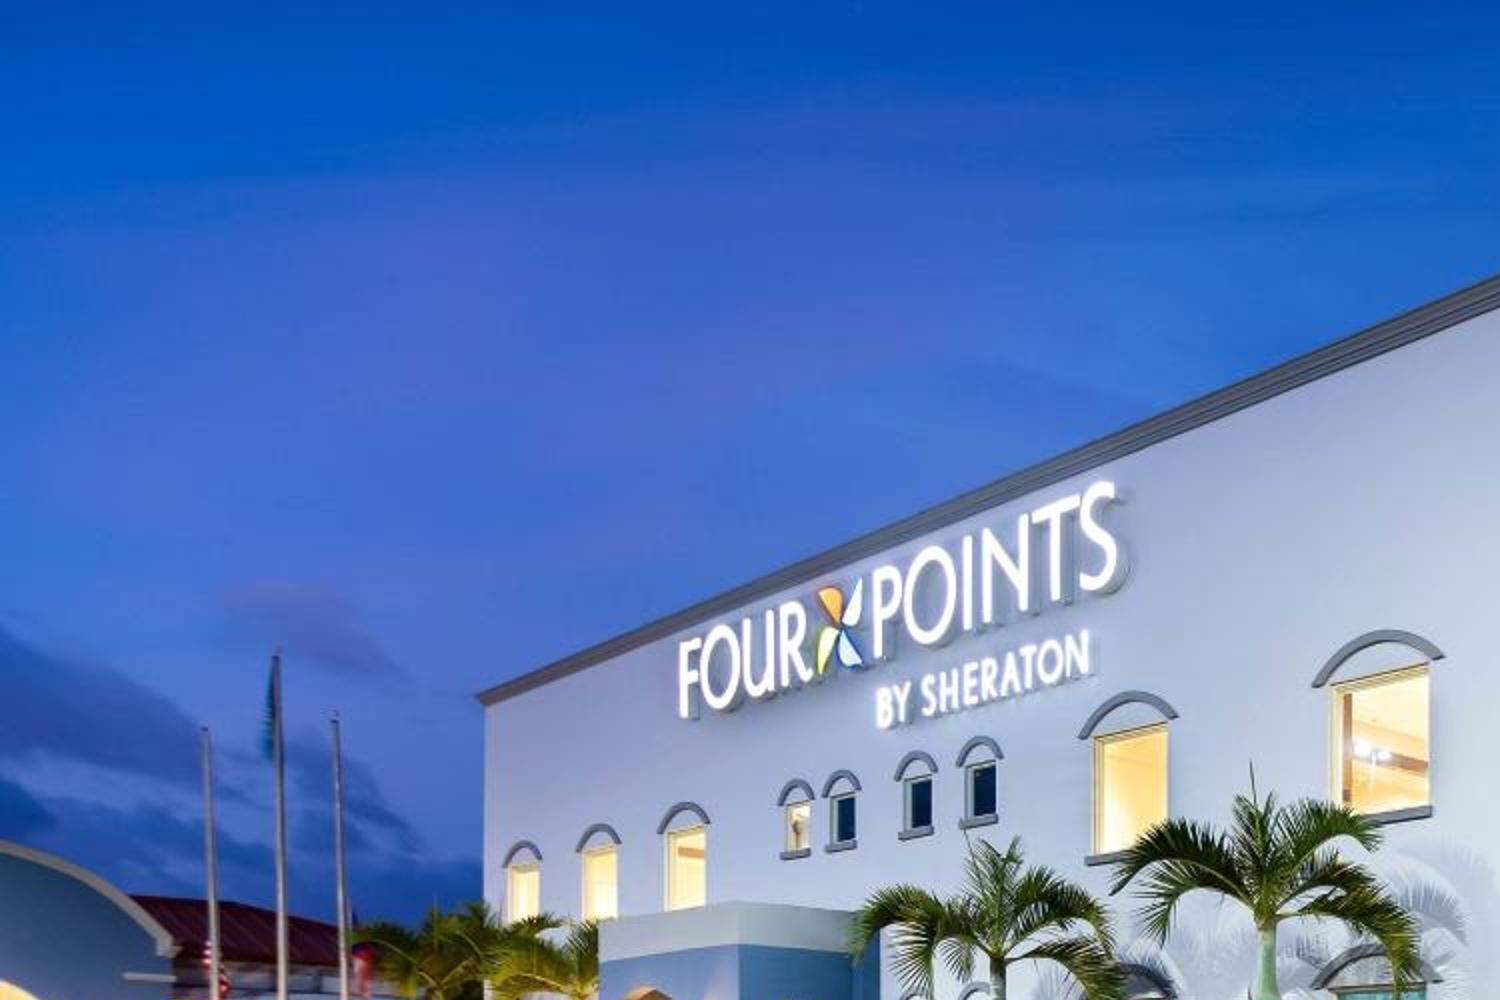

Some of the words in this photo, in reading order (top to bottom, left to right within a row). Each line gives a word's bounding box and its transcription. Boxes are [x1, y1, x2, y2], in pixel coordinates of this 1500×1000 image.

[678, 600, 813, 719] FOUR
[872, 480, 1118, 659] POINTS
[876, 683, 911, 730] BY
[921, 629, 1090, 717] SHERATON
